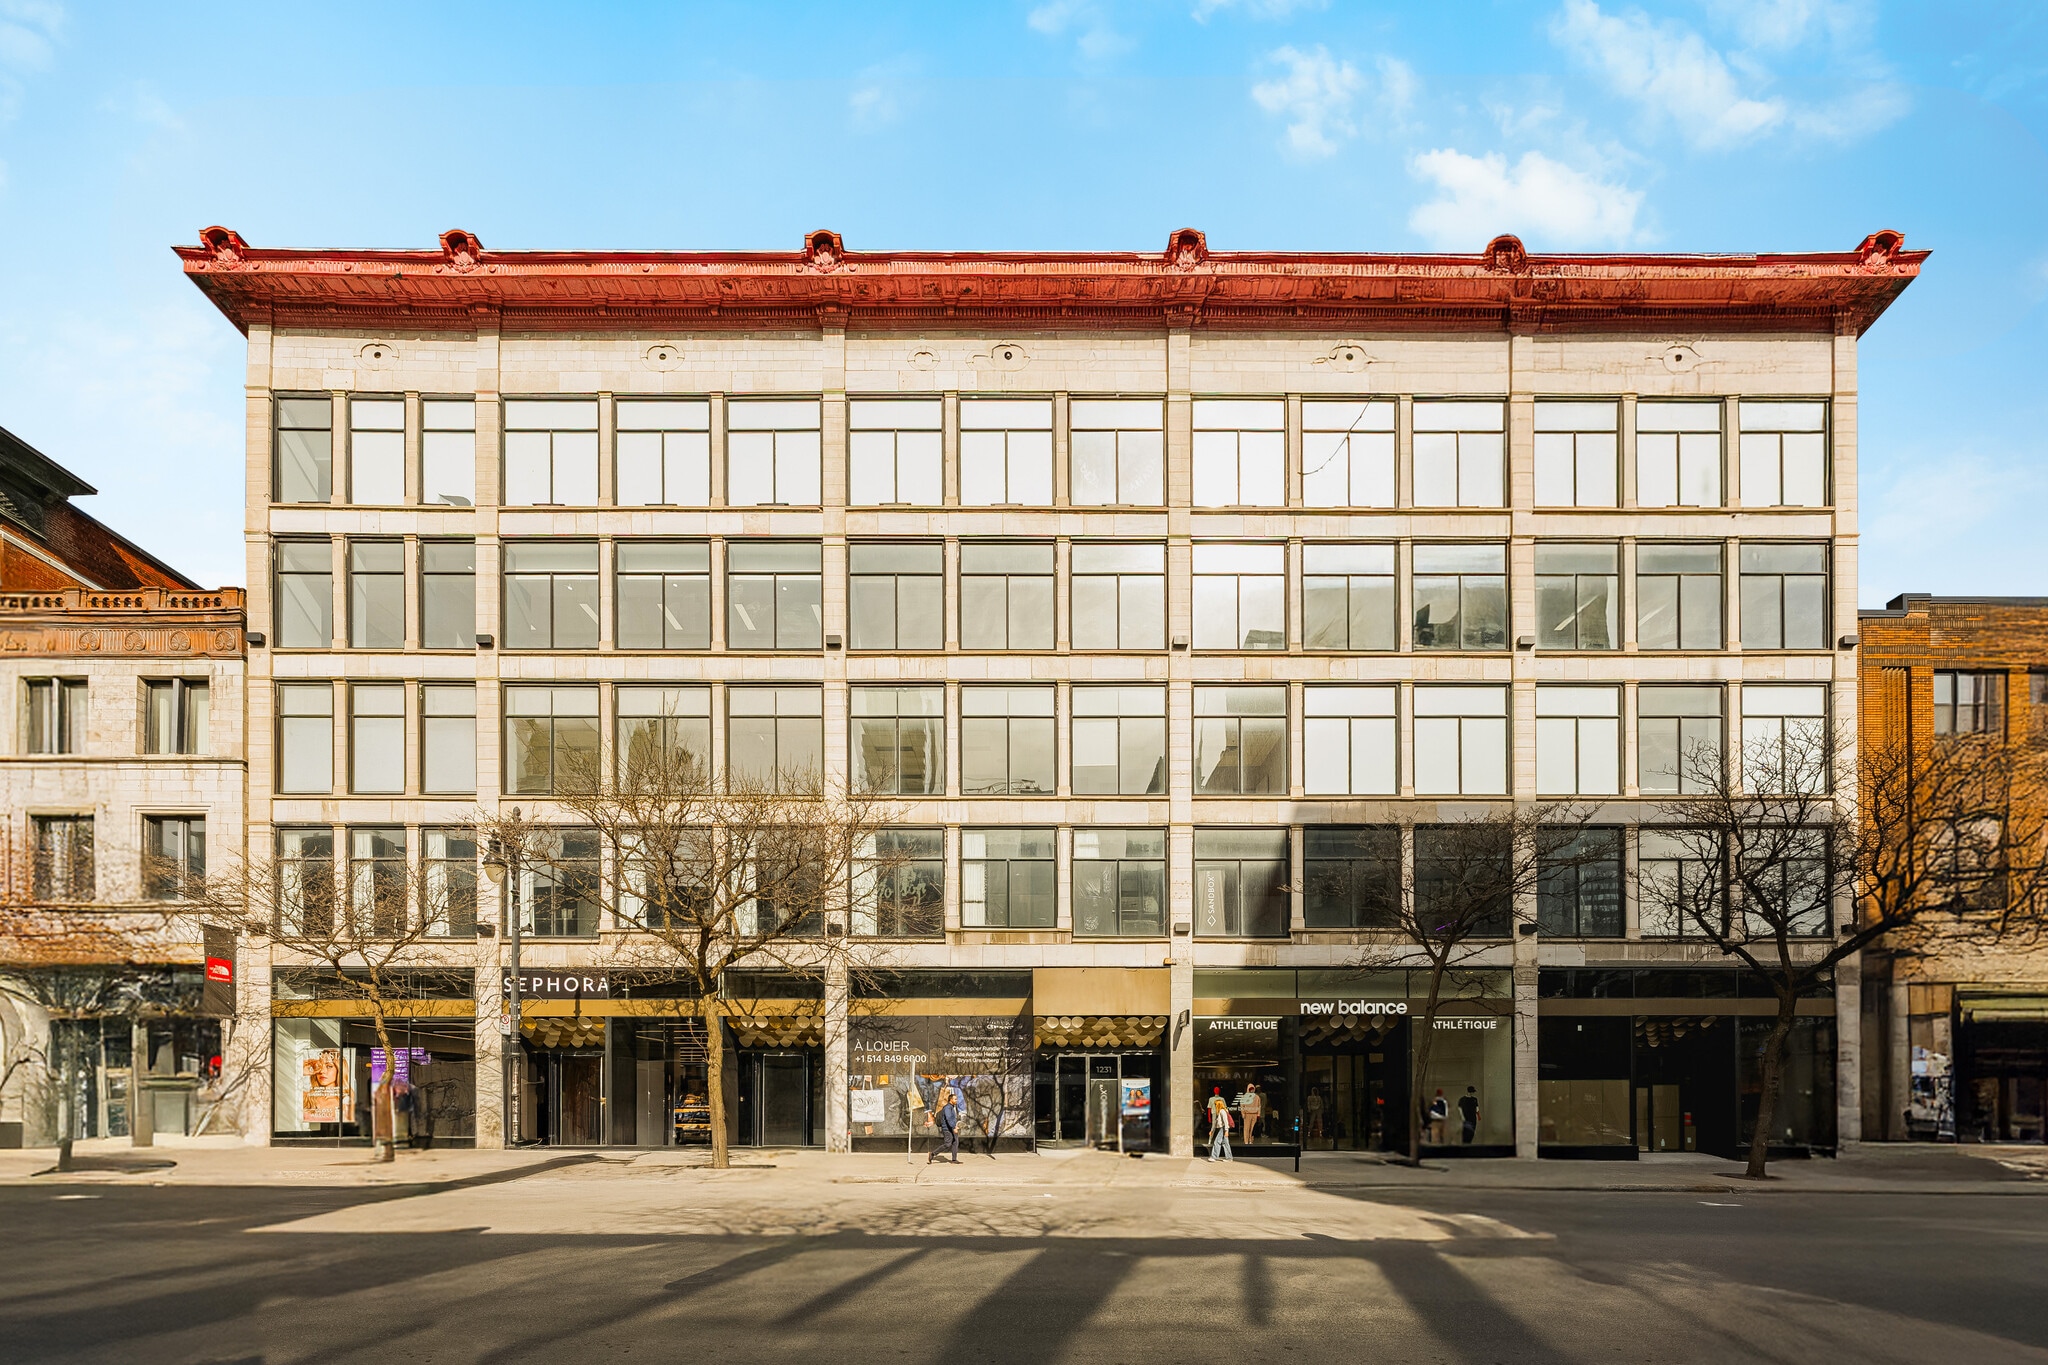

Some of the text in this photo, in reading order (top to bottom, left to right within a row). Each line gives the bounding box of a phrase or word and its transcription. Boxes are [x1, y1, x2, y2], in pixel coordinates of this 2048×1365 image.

[503, 977, 608, 992] SEPHORA
[1300, 1000, 1407, 1014] new balance
[1209, 1019, 1278, 1030] ATHLÉTIQUE
[854, 1038, 910, 1051] À LOUER
[855, 1055, 865, 1063] +1
[866, 1055, 882, 1063] 514
[884, 1055, 902, 1063] 849
